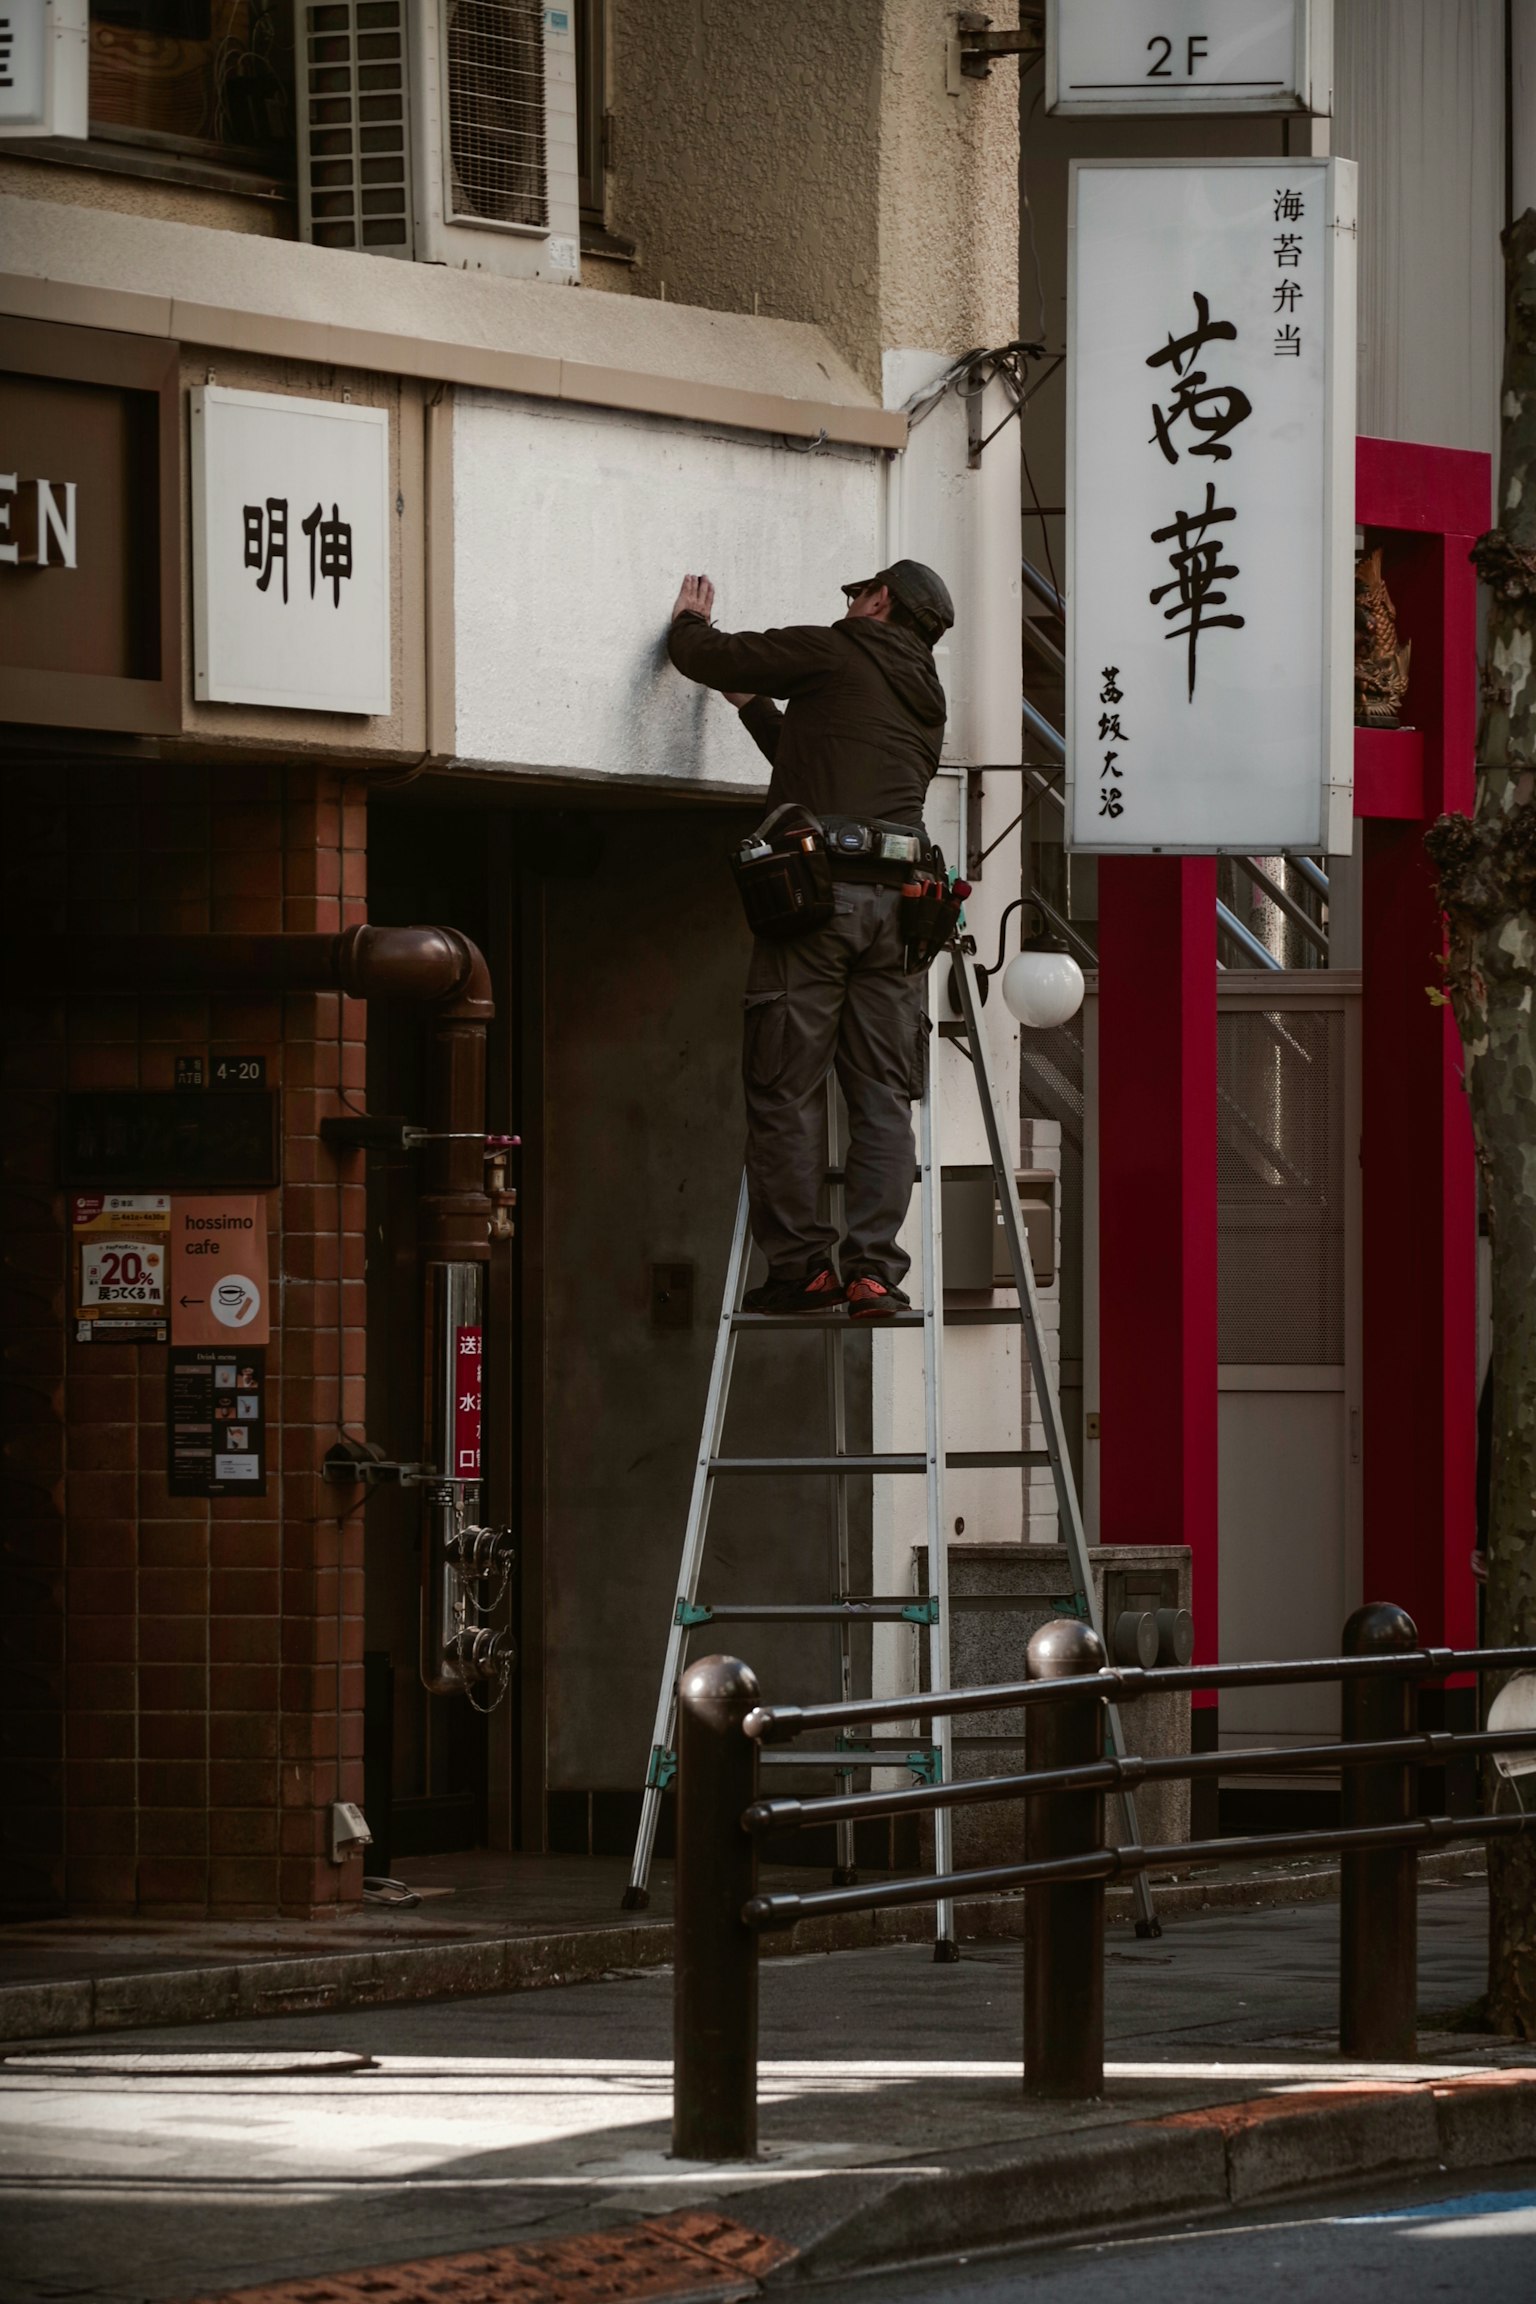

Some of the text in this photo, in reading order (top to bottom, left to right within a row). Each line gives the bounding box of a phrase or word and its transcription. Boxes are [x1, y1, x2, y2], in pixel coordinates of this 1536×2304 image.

[1146, 36, 1208, 76] 2F
[1273, 188, 1305, 358] 海苔弁当
[1145, 291, 1252, 704] 茜華
[243, 497, 352, 609] 明伸
[216, 1062, 260, 1080] 4-20
[185, 1214, 254, 1231] hossimo
[185, 1239, 221, 1255] cafe
[101, 1252, 154, 1286] 20%
[98, 1286, 146, 1301] 戻ってくる
[459, 1335, 477, 1468] 送水口
